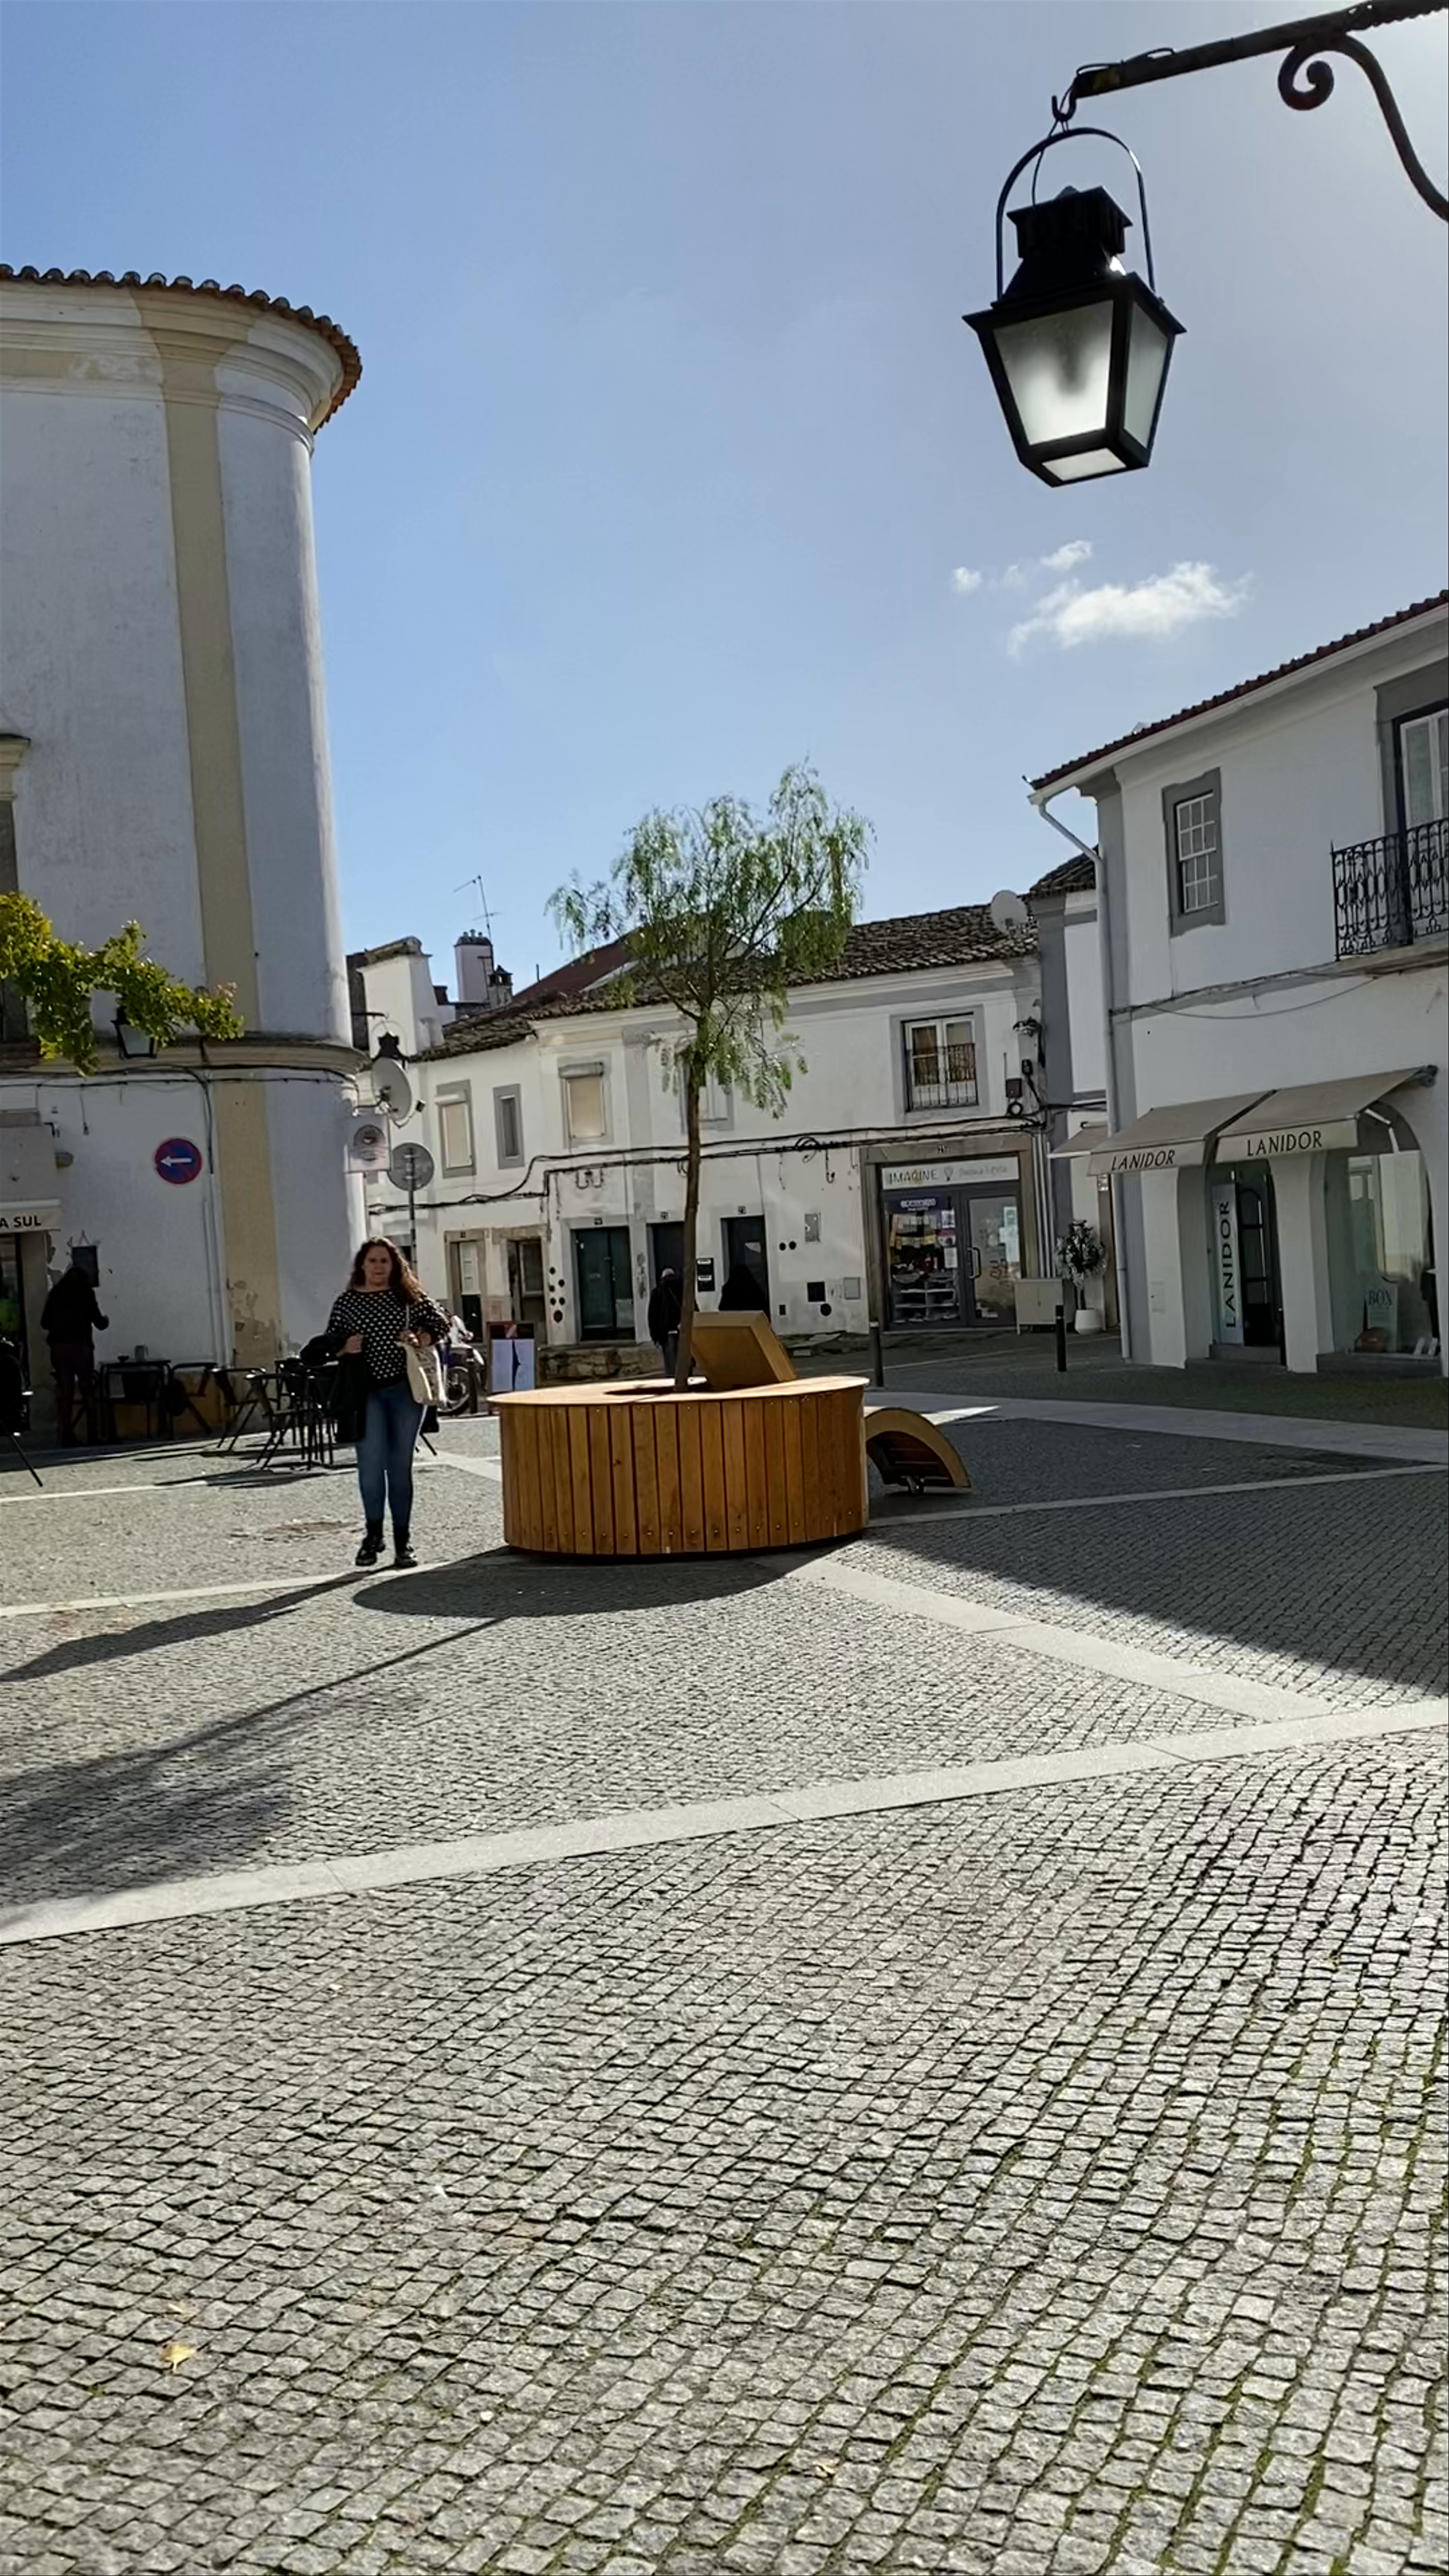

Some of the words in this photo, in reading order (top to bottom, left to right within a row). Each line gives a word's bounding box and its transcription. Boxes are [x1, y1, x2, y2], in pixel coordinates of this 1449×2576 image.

[1247, 1130, 1323, 1157] LANIDOR
[1111, 1150, 1175, 1170] LANIDOR
[14, 1215, 42, 1228] SUL
[1219, 1201, 1236, 1328] LANIDOR
